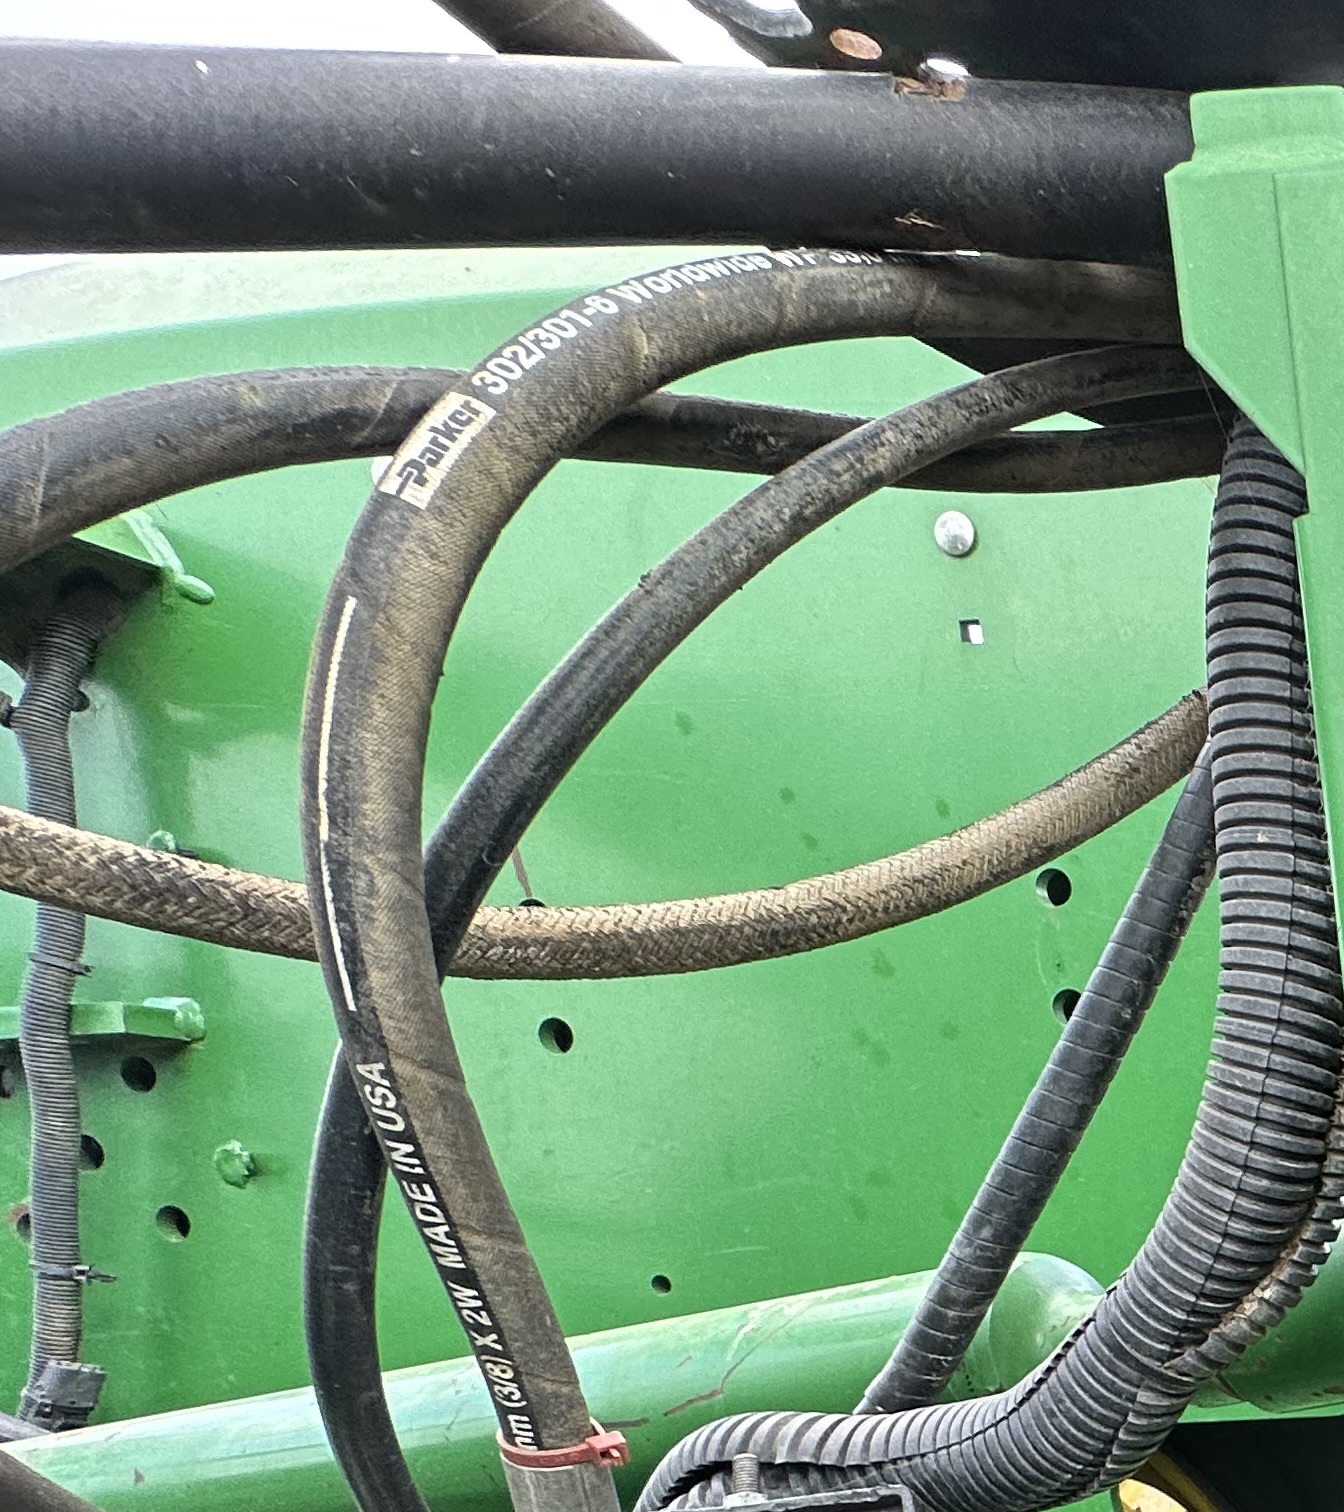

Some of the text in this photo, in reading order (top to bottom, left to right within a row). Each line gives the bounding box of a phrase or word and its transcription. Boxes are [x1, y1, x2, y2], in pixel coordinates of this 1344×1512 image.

[394, 399, 483, 497] Parker
[471, 295, 619, 396] 302/301-6
[606, 251, 773, 305] Worldwide
[355, 1061, 406, 1132] USA
[383, 1138, 427, 1175] IN
[401, 1178, 467, 1269] MADE
[446, 1280, 493, 1327] 2W
[468, 1329, 504, 1351] X
[480, 1354, 528, 1409] (3/8)
